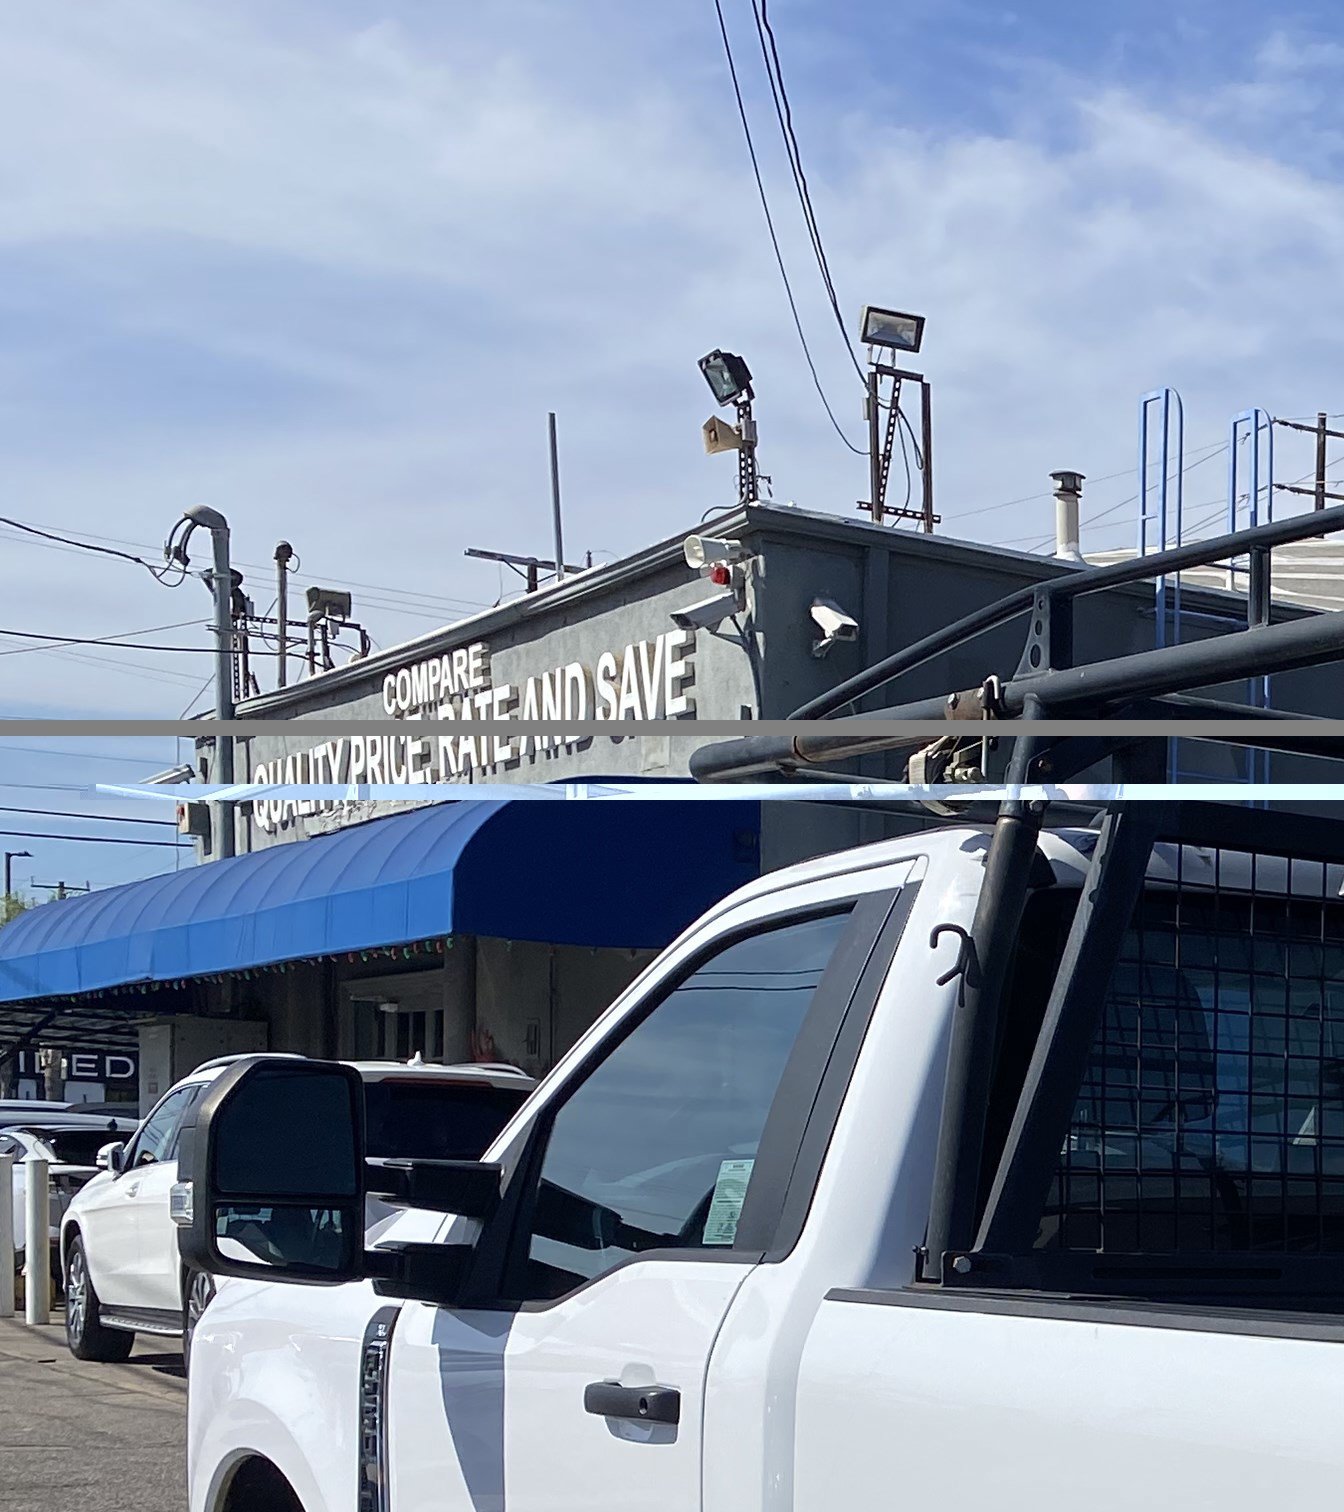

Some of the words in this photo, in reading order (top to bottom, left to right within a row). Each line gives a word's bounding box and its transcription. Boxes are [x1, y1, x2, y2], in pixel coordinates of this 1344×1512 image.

[383, 641, 484, 716] COMPARE
[438, 684, 511, 778] RATE
[520, 662, 587, 757] AND
[596, 629, 687, 727] SAVE
